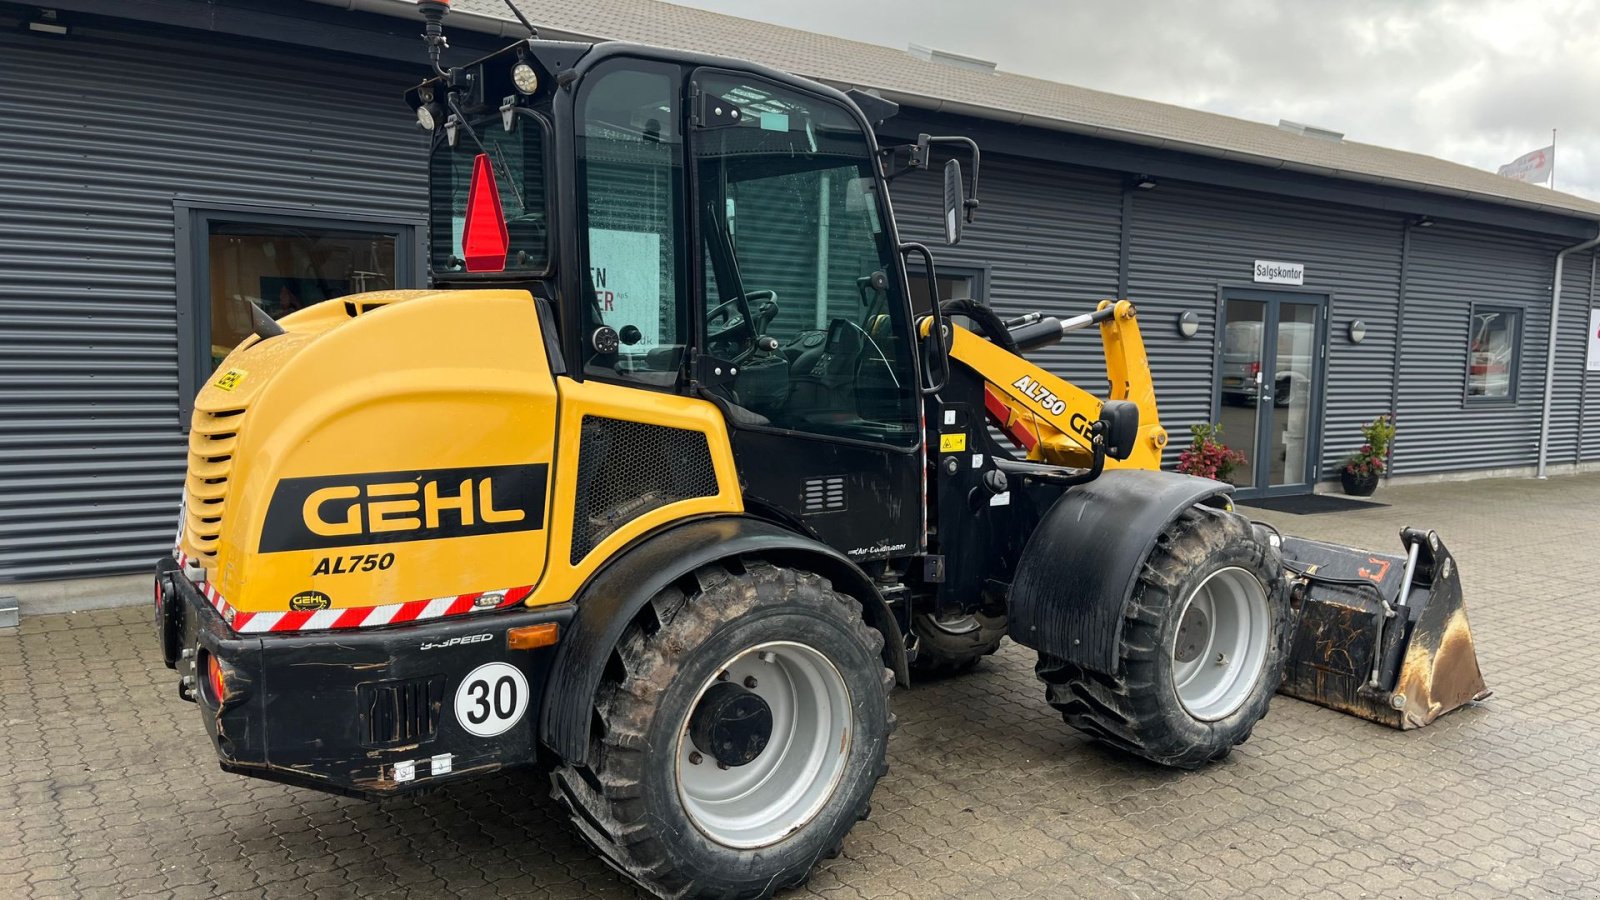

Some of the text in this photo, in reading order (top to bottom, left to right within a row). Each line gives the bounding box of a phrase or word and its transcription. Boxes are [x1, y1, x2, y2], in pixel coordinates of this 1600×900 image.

[1256, 264, 1302, 280] Salgskontor
[1011, 374, 1067, 417] AL750
[302, 476, 526, 537] GEHL
[311, 552, 396, 577] AL750
[292, 595, 328, 605] GEHL
[466, 675, 518, 725] 30
